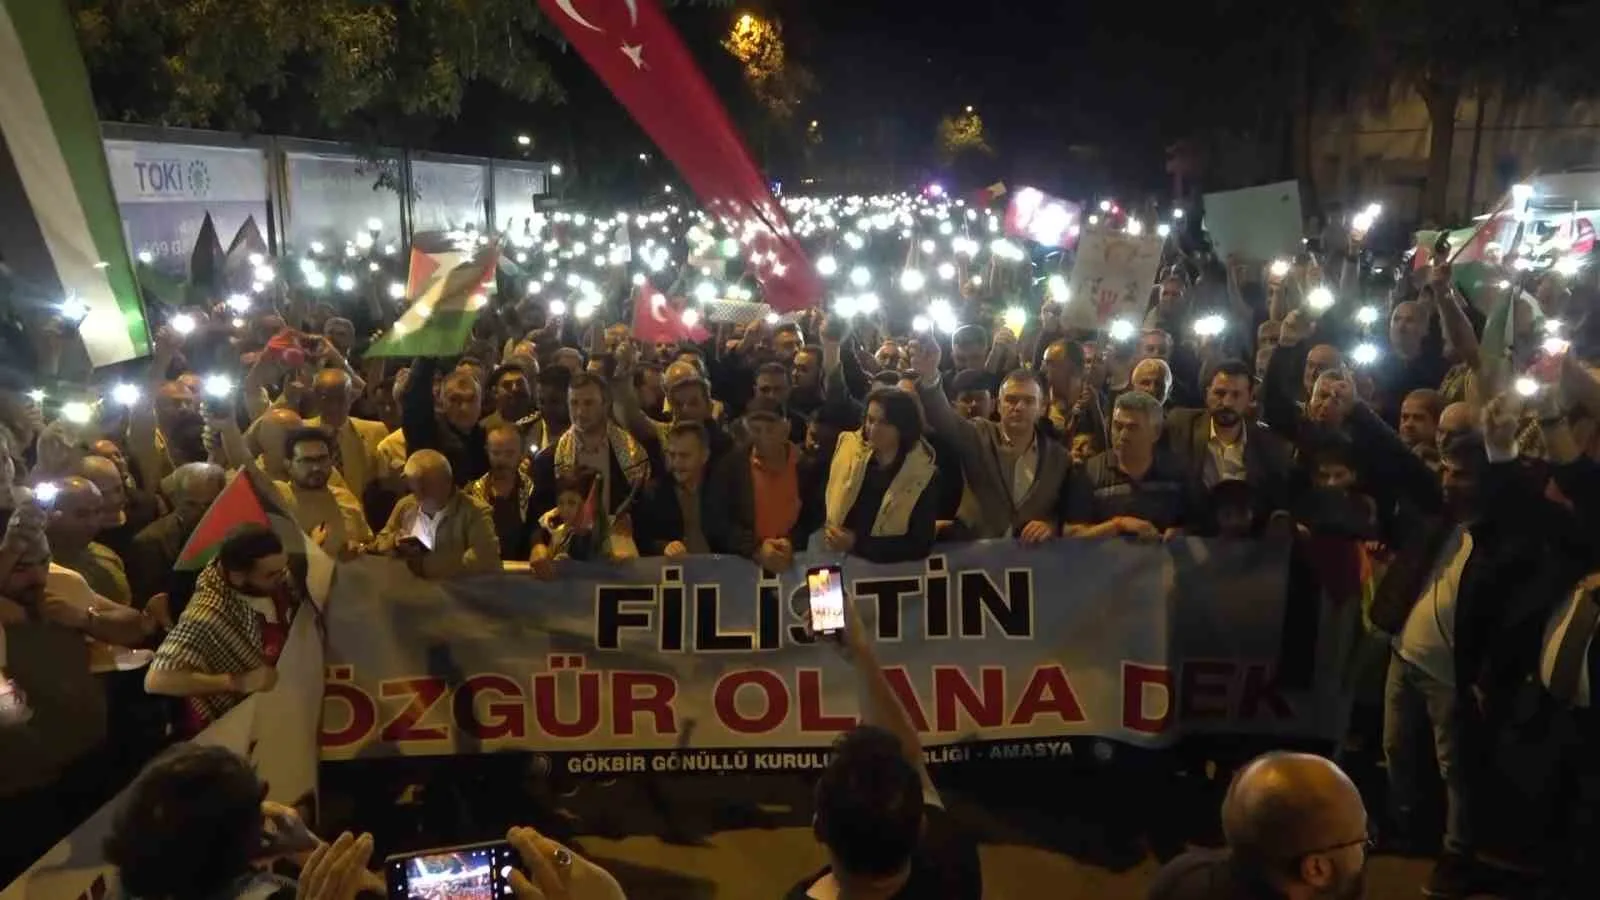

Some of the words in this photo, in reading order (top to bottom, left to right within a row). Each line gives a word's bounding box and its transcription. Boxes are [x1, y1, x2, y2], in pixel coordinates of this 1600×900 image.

[318, 653, 679, 747] ÖZGÜR
[1121, 660, 1297, 735] DEK
[567, 753, 646, 773] GÖKBİR
[651, 751, 748, 772] GÖNÜLLÜ
[989, 741, 1073, 761] AMASYA
